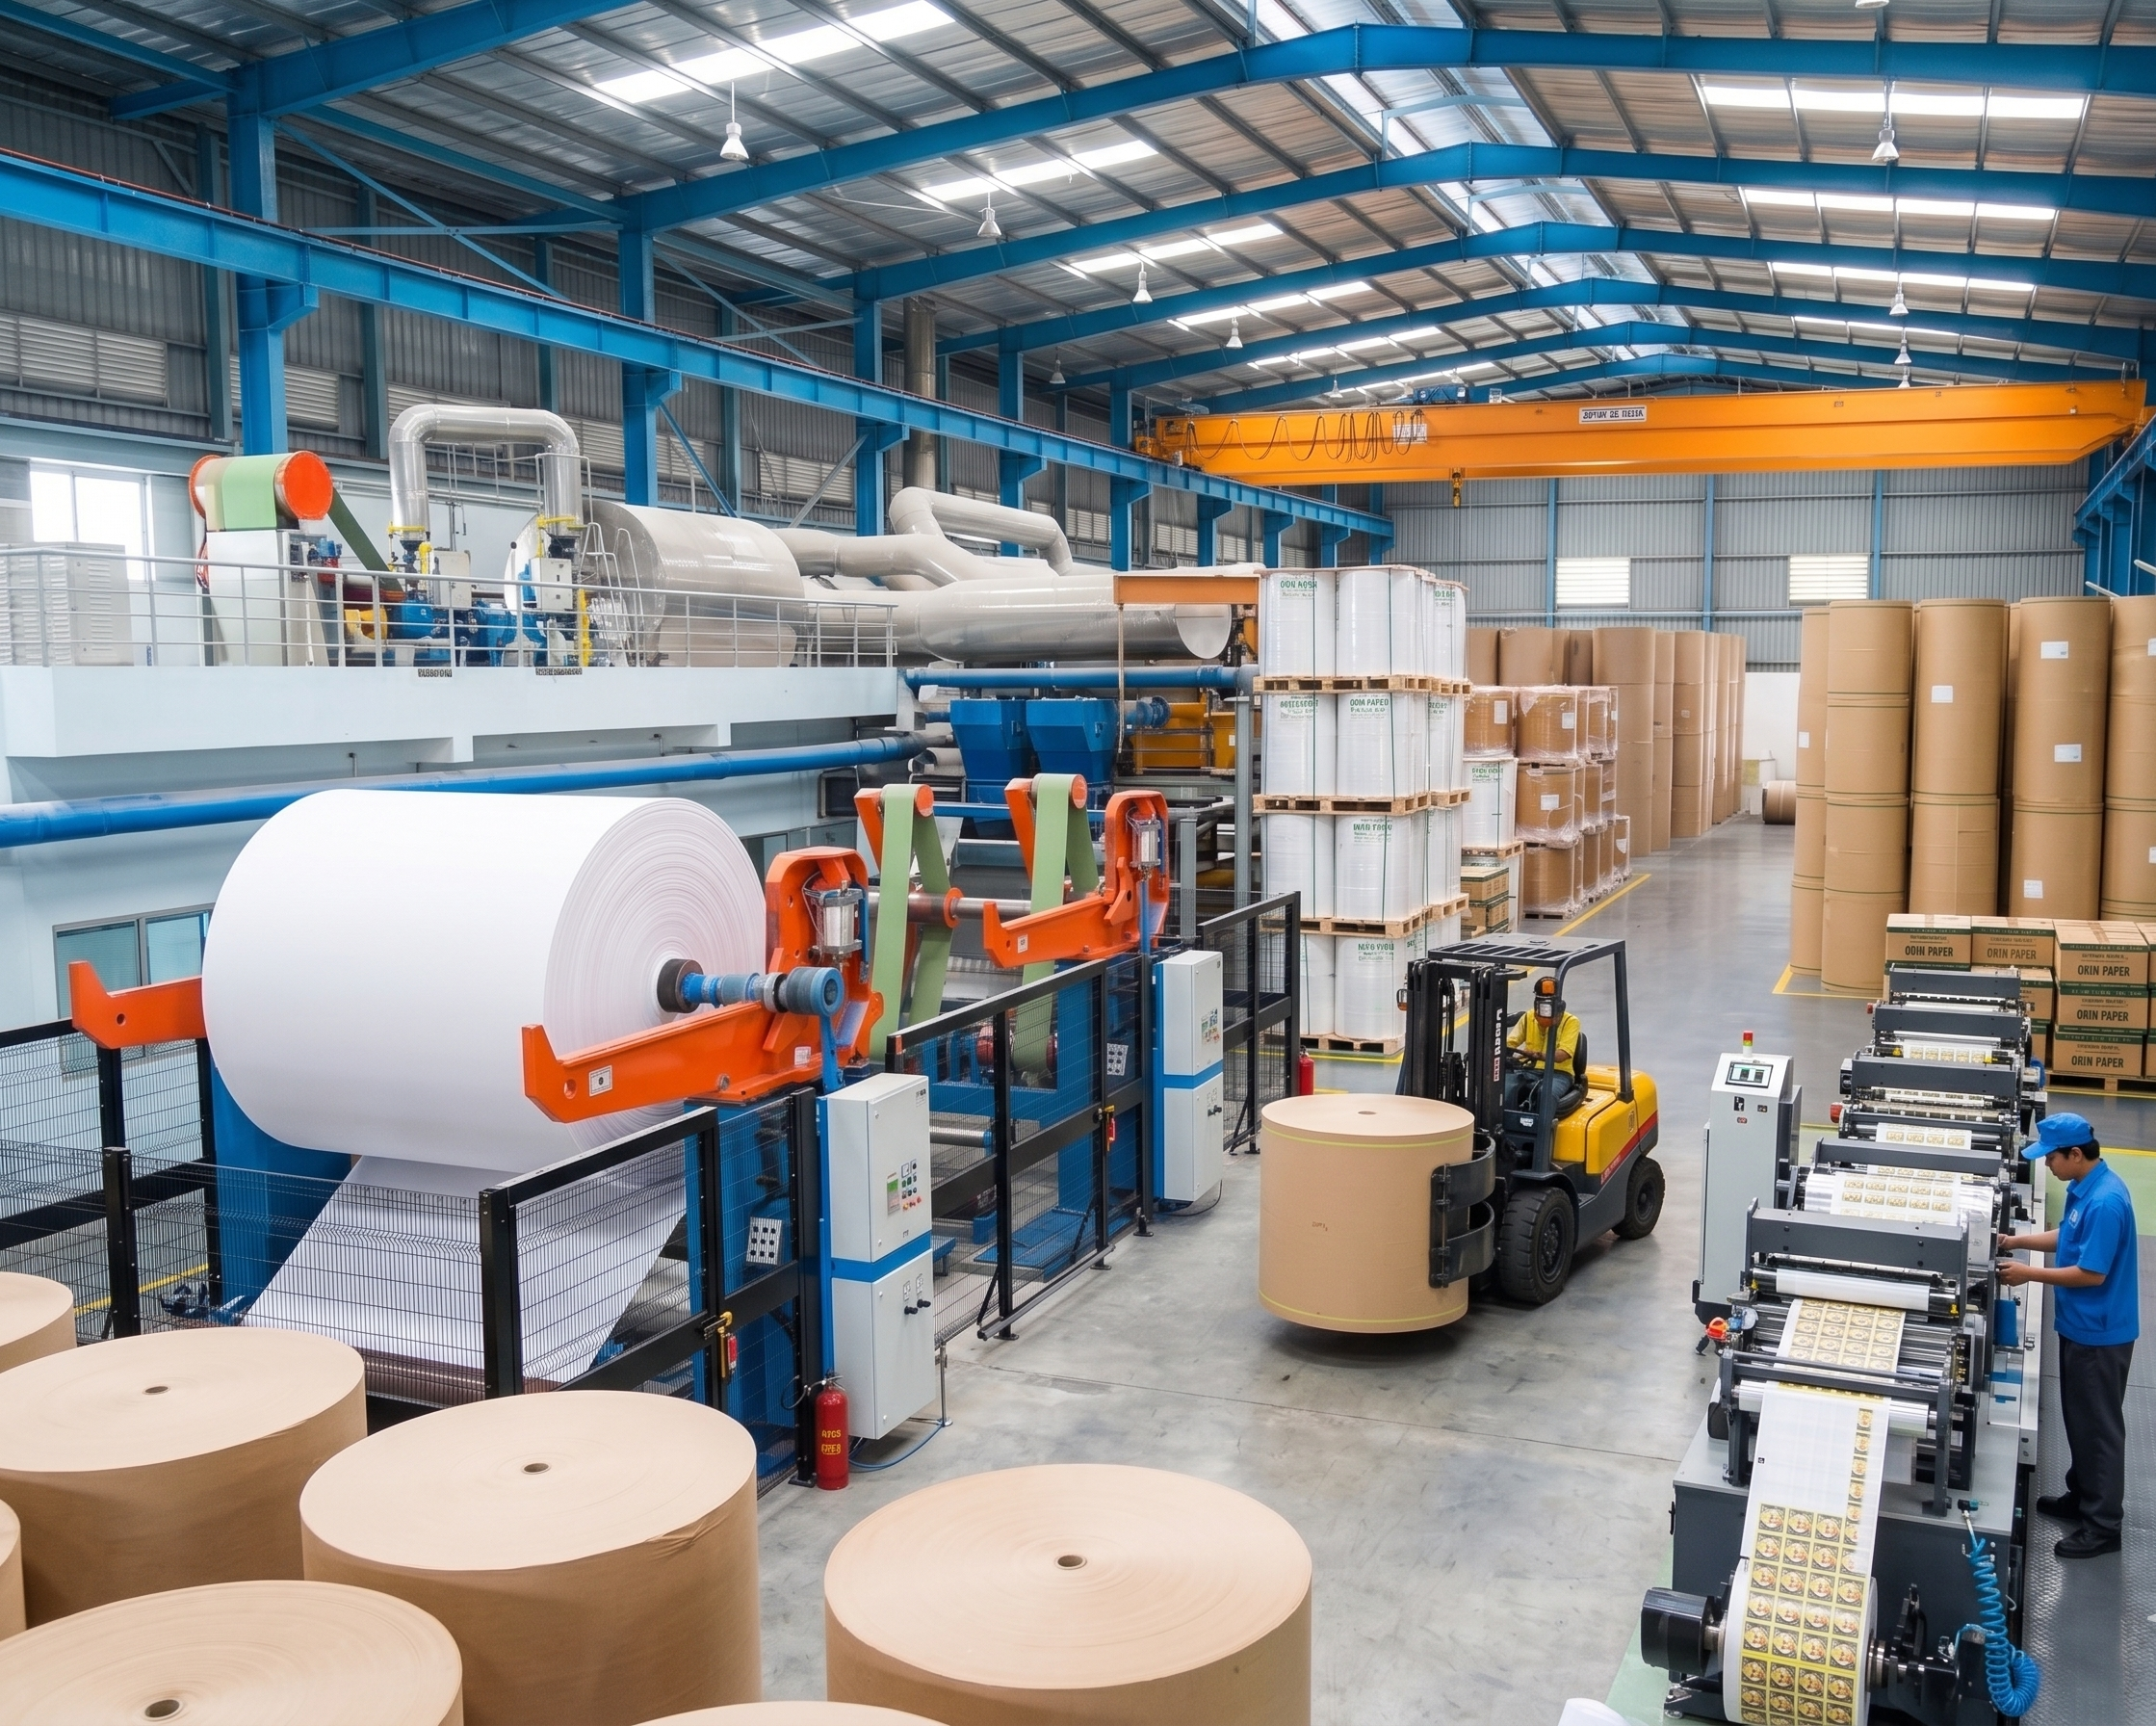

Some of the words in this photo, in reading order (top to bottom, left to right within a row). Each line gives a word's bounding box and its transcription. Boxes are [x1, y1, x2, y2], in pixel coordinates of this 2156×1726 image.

[1928, 946, 1954, 956] PAPER
[1987, 948, 2009, 959] ORIN
[2011, 949, 2037, 959] PAPER
[2102, 965, 2130, 977] PAPER
[2076, 1009, 2098, 1021] ORIN
[2101, 1010, 2129, 1022] PAPER
[2071, 1055, 2093, 1066] ORIN
[2095, 1057, 2124, 1068] PAPER
